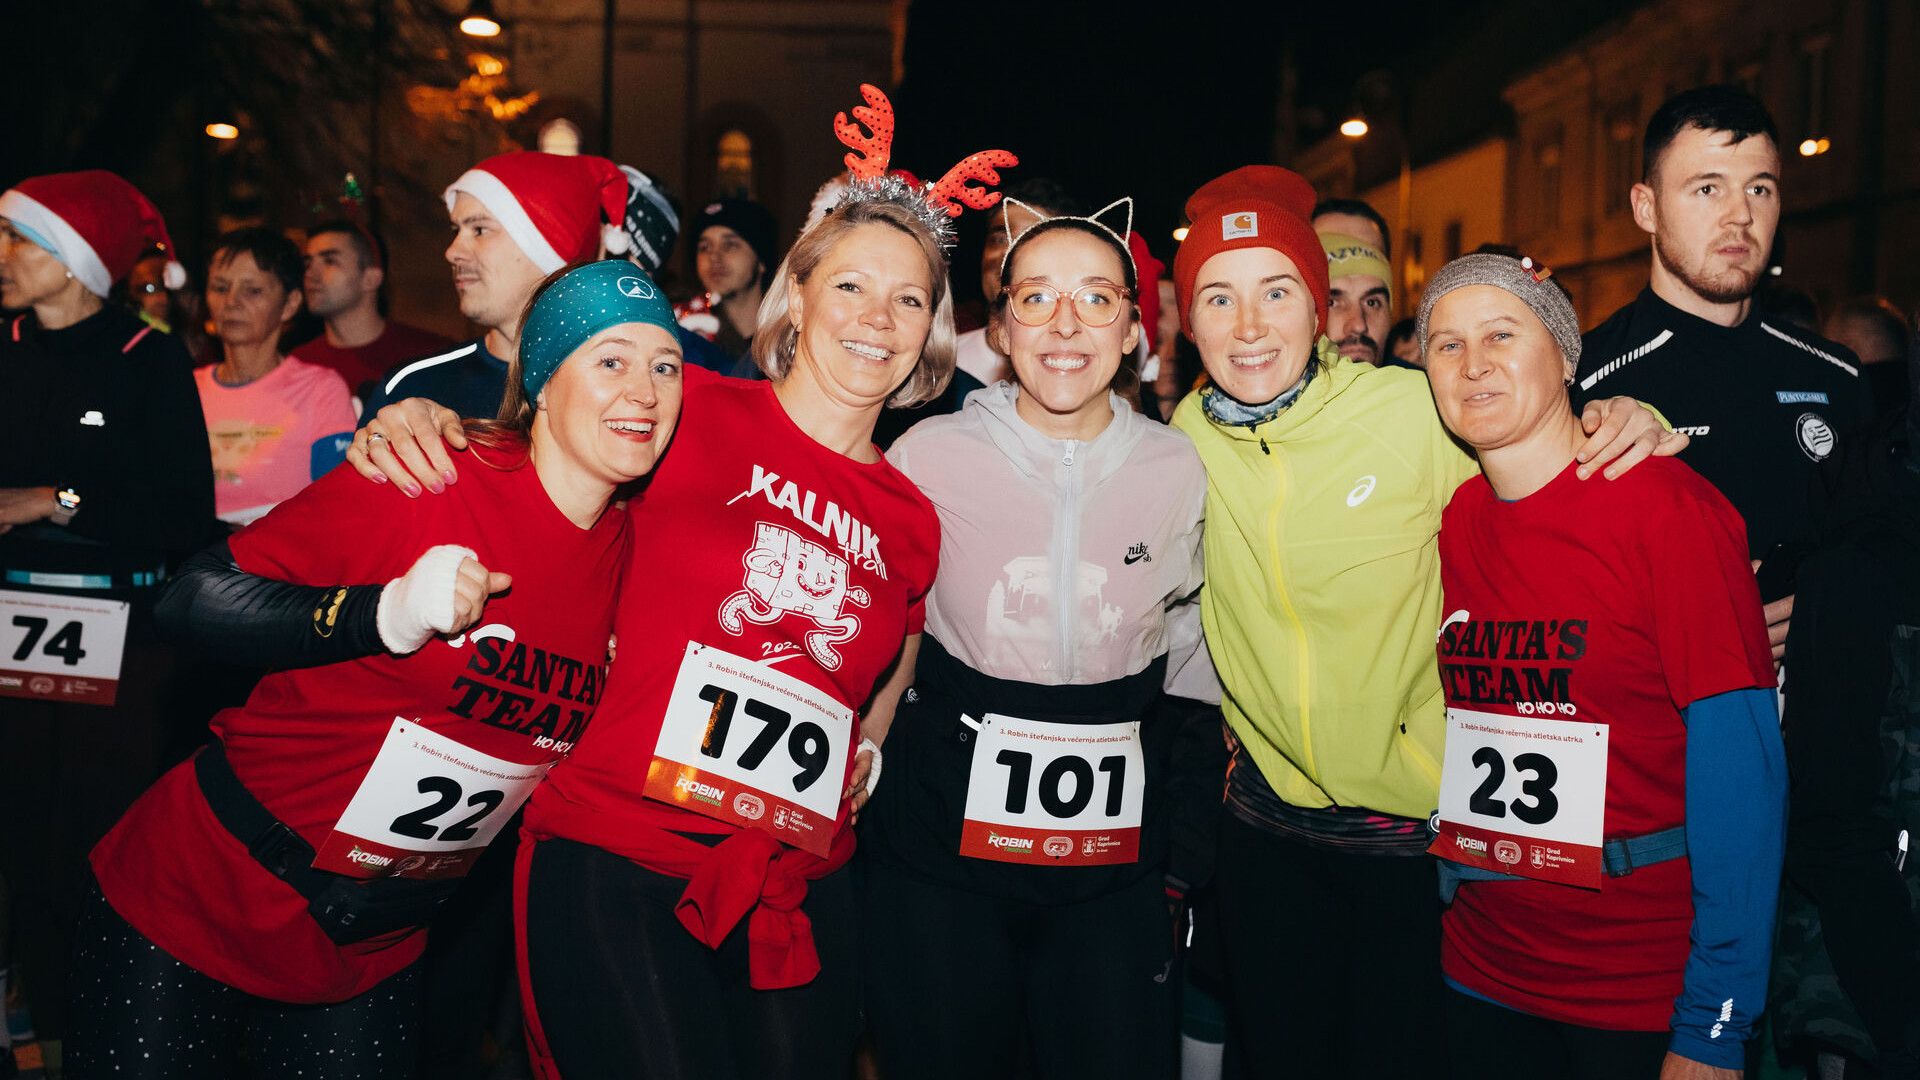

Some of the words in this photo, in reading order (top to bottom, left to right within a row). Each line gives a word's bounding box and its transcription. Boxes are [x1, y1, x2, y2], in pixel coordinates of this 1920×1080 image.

[749, 464, 882, 565] KALNIK
[12, 615, 86, 666] 74
[1442, 619, 1589, 662] SANTA'S
[707, 661, 715, 669] 3.
[715, 664, 738, 676] Robin
[803, 697, 825, 714] atletska
[1444, 663, 1573, 705] TEAM
[1516, 701, 1535, 714] HO
[1535, 701, 1556, 714] HO
[1556, 702, 1577, 716] HO
[532, 735, 554, 749] HO
[699, 684, 830, 793] 179
[1007, 730, 1028, 738] Robin
[1465, 723, 1479, 731] Robin
[1533, 732, 1562, 741] atletska
[1563, 735, 1584, 743] utrka
[421, 744, 442, 758] Robin
[676, 777, 725, 801] ROBIN
[996, 749, 1126, 818] 101
[1469, 746, 1558, 825] 23
[389, 776, 505, 841] 22
[347, 850, 394, 867] ROBIN
[988, 835, 1034, 849] ROBIN
[1456, 836, 1488, 852] ROBIN
